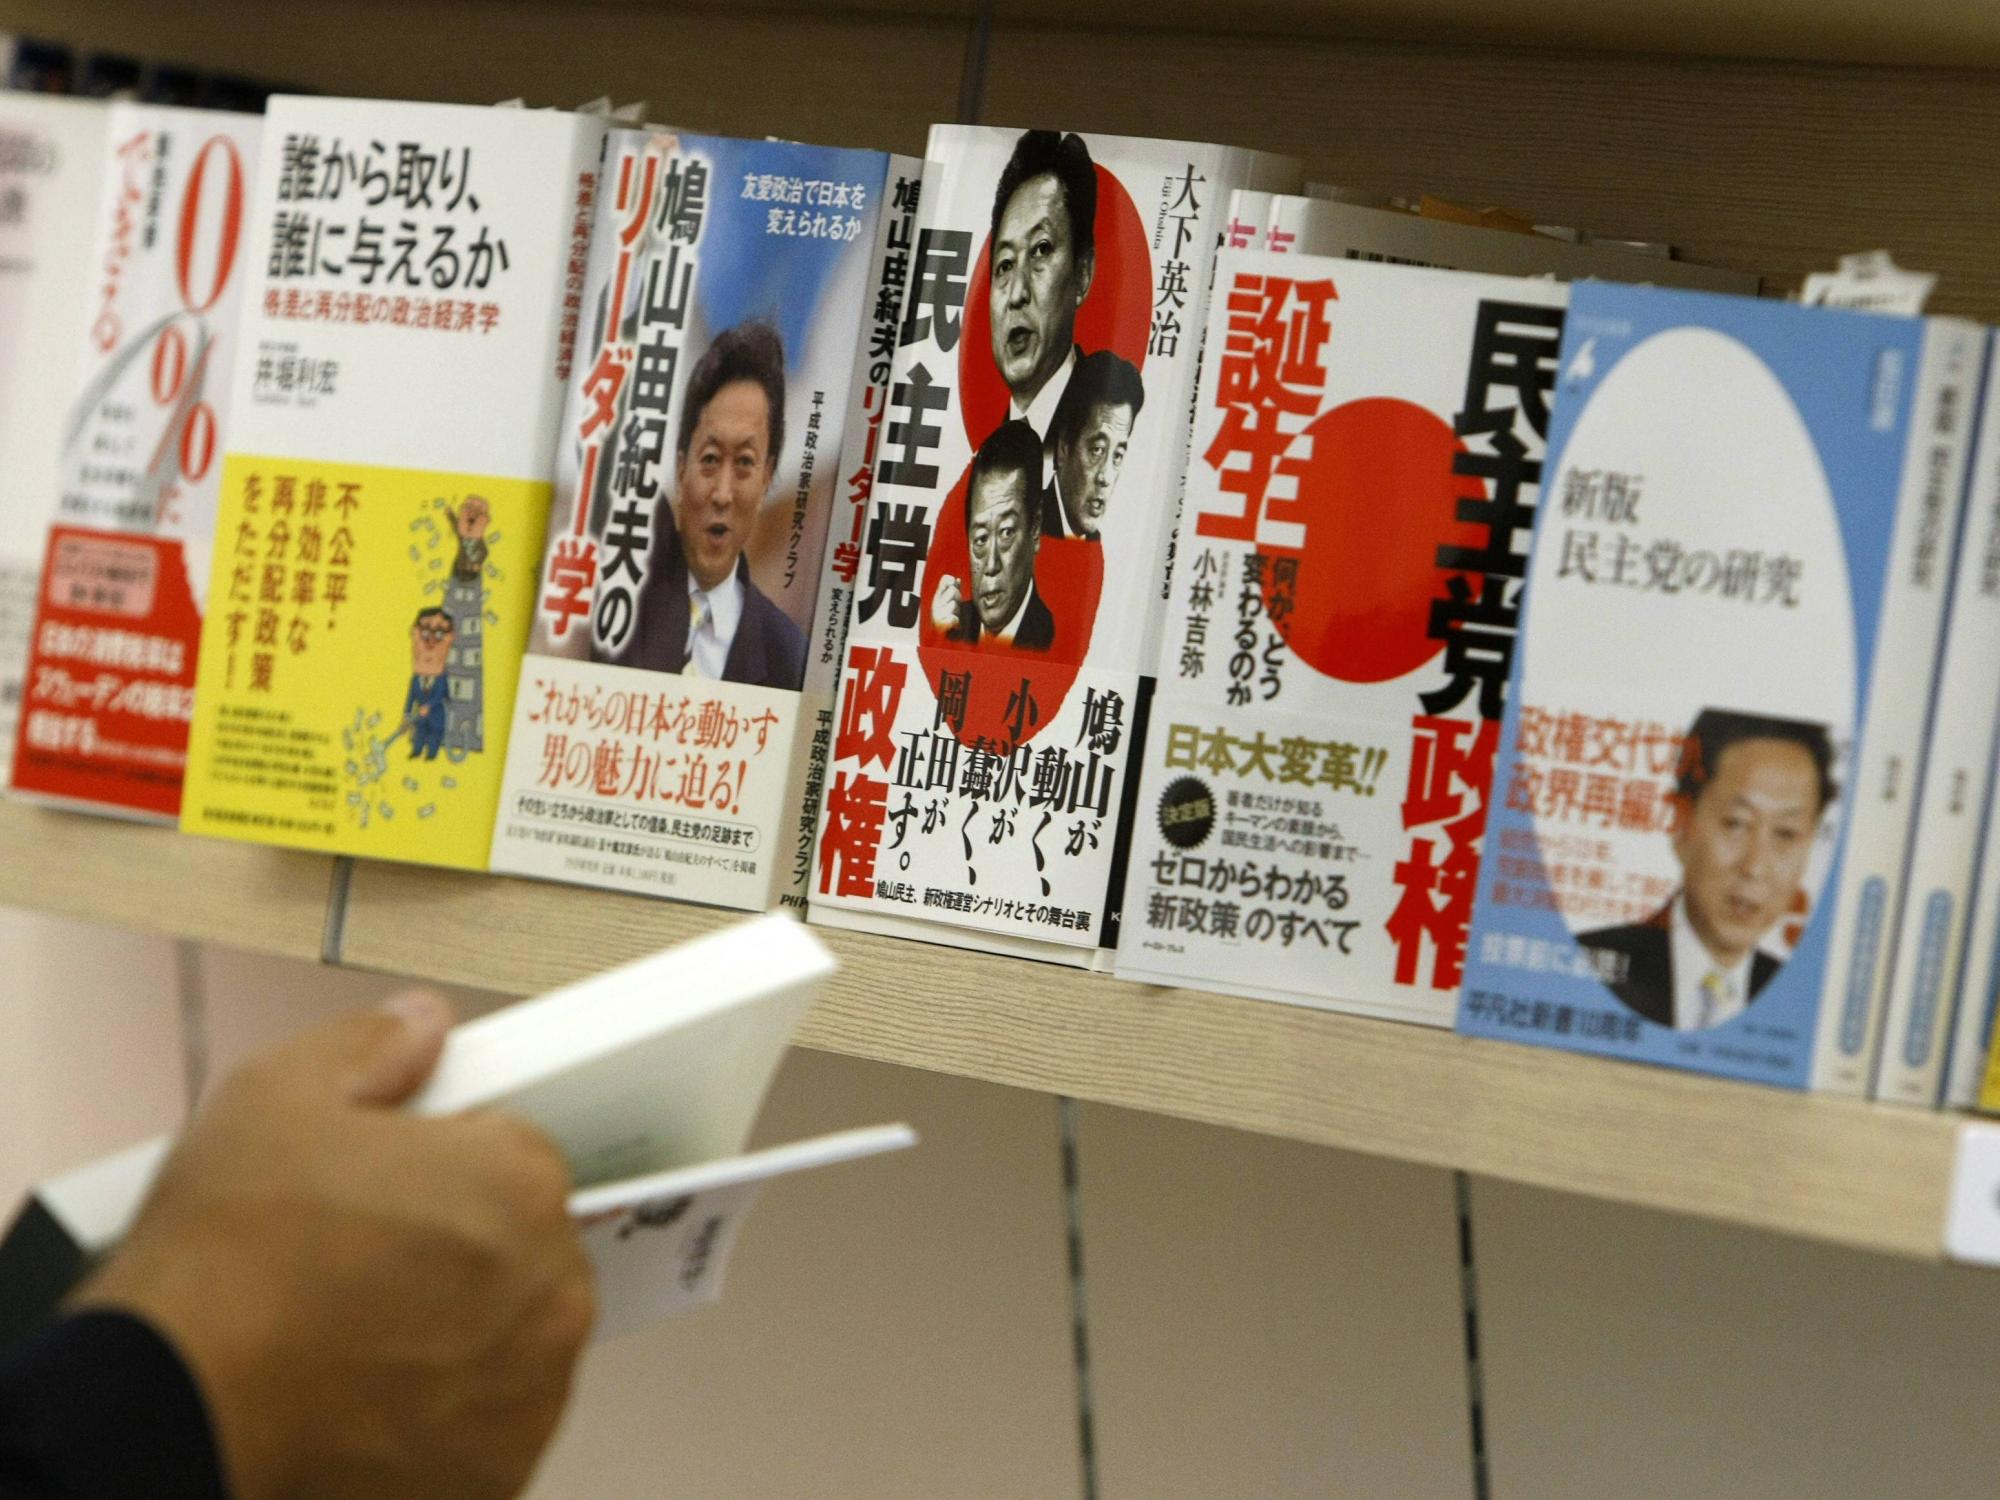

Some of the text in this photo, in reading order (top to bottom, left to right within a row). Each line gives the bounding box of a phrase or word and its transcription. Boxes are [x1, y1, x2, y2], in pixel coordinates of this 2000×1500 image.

[277, 132, 482, 212] 誰から取り、
[741, 172, 867, 211] 友愛政治で日本を
[766, 206, 861, 242] 変えられるか
[262, 288, 502, 334] 格差と再分配の政治経済学
[266, 211, 510, 290] 誰に与えるか
[1148, 163, 1207, 358] 大下英治
[543, 155, 658, 637] リーダー学
[597, 156, 709, 650] 鳩山由紀夫の
[1195, 272, 1340, 550] 誕生
[819, 228, 973, 901] 民主党政権
[1556, 528, 1805, 609] 民主党の研究
[1561, 466, 1645, 525] 新版
[1179, 547, 1217, 680] 小林吉弥
[1226, 552, 1269, 707] 変わるのか
[1384, 298, 1567, 991] 民主党政権
[527, 678, 779, 757] これからの日本を動かす
[920, 669, 973, 836] 岡田が
[988, 677, 1040, 845] 小沢が
[1064, 685, 1125, 857] 鳩山が
[792, 709, 833, 886] 平成政治家研究クラブ
[887, 727, 933, 872] 正す。
[1150, 849, 1350, 911] ゼロからわかる
